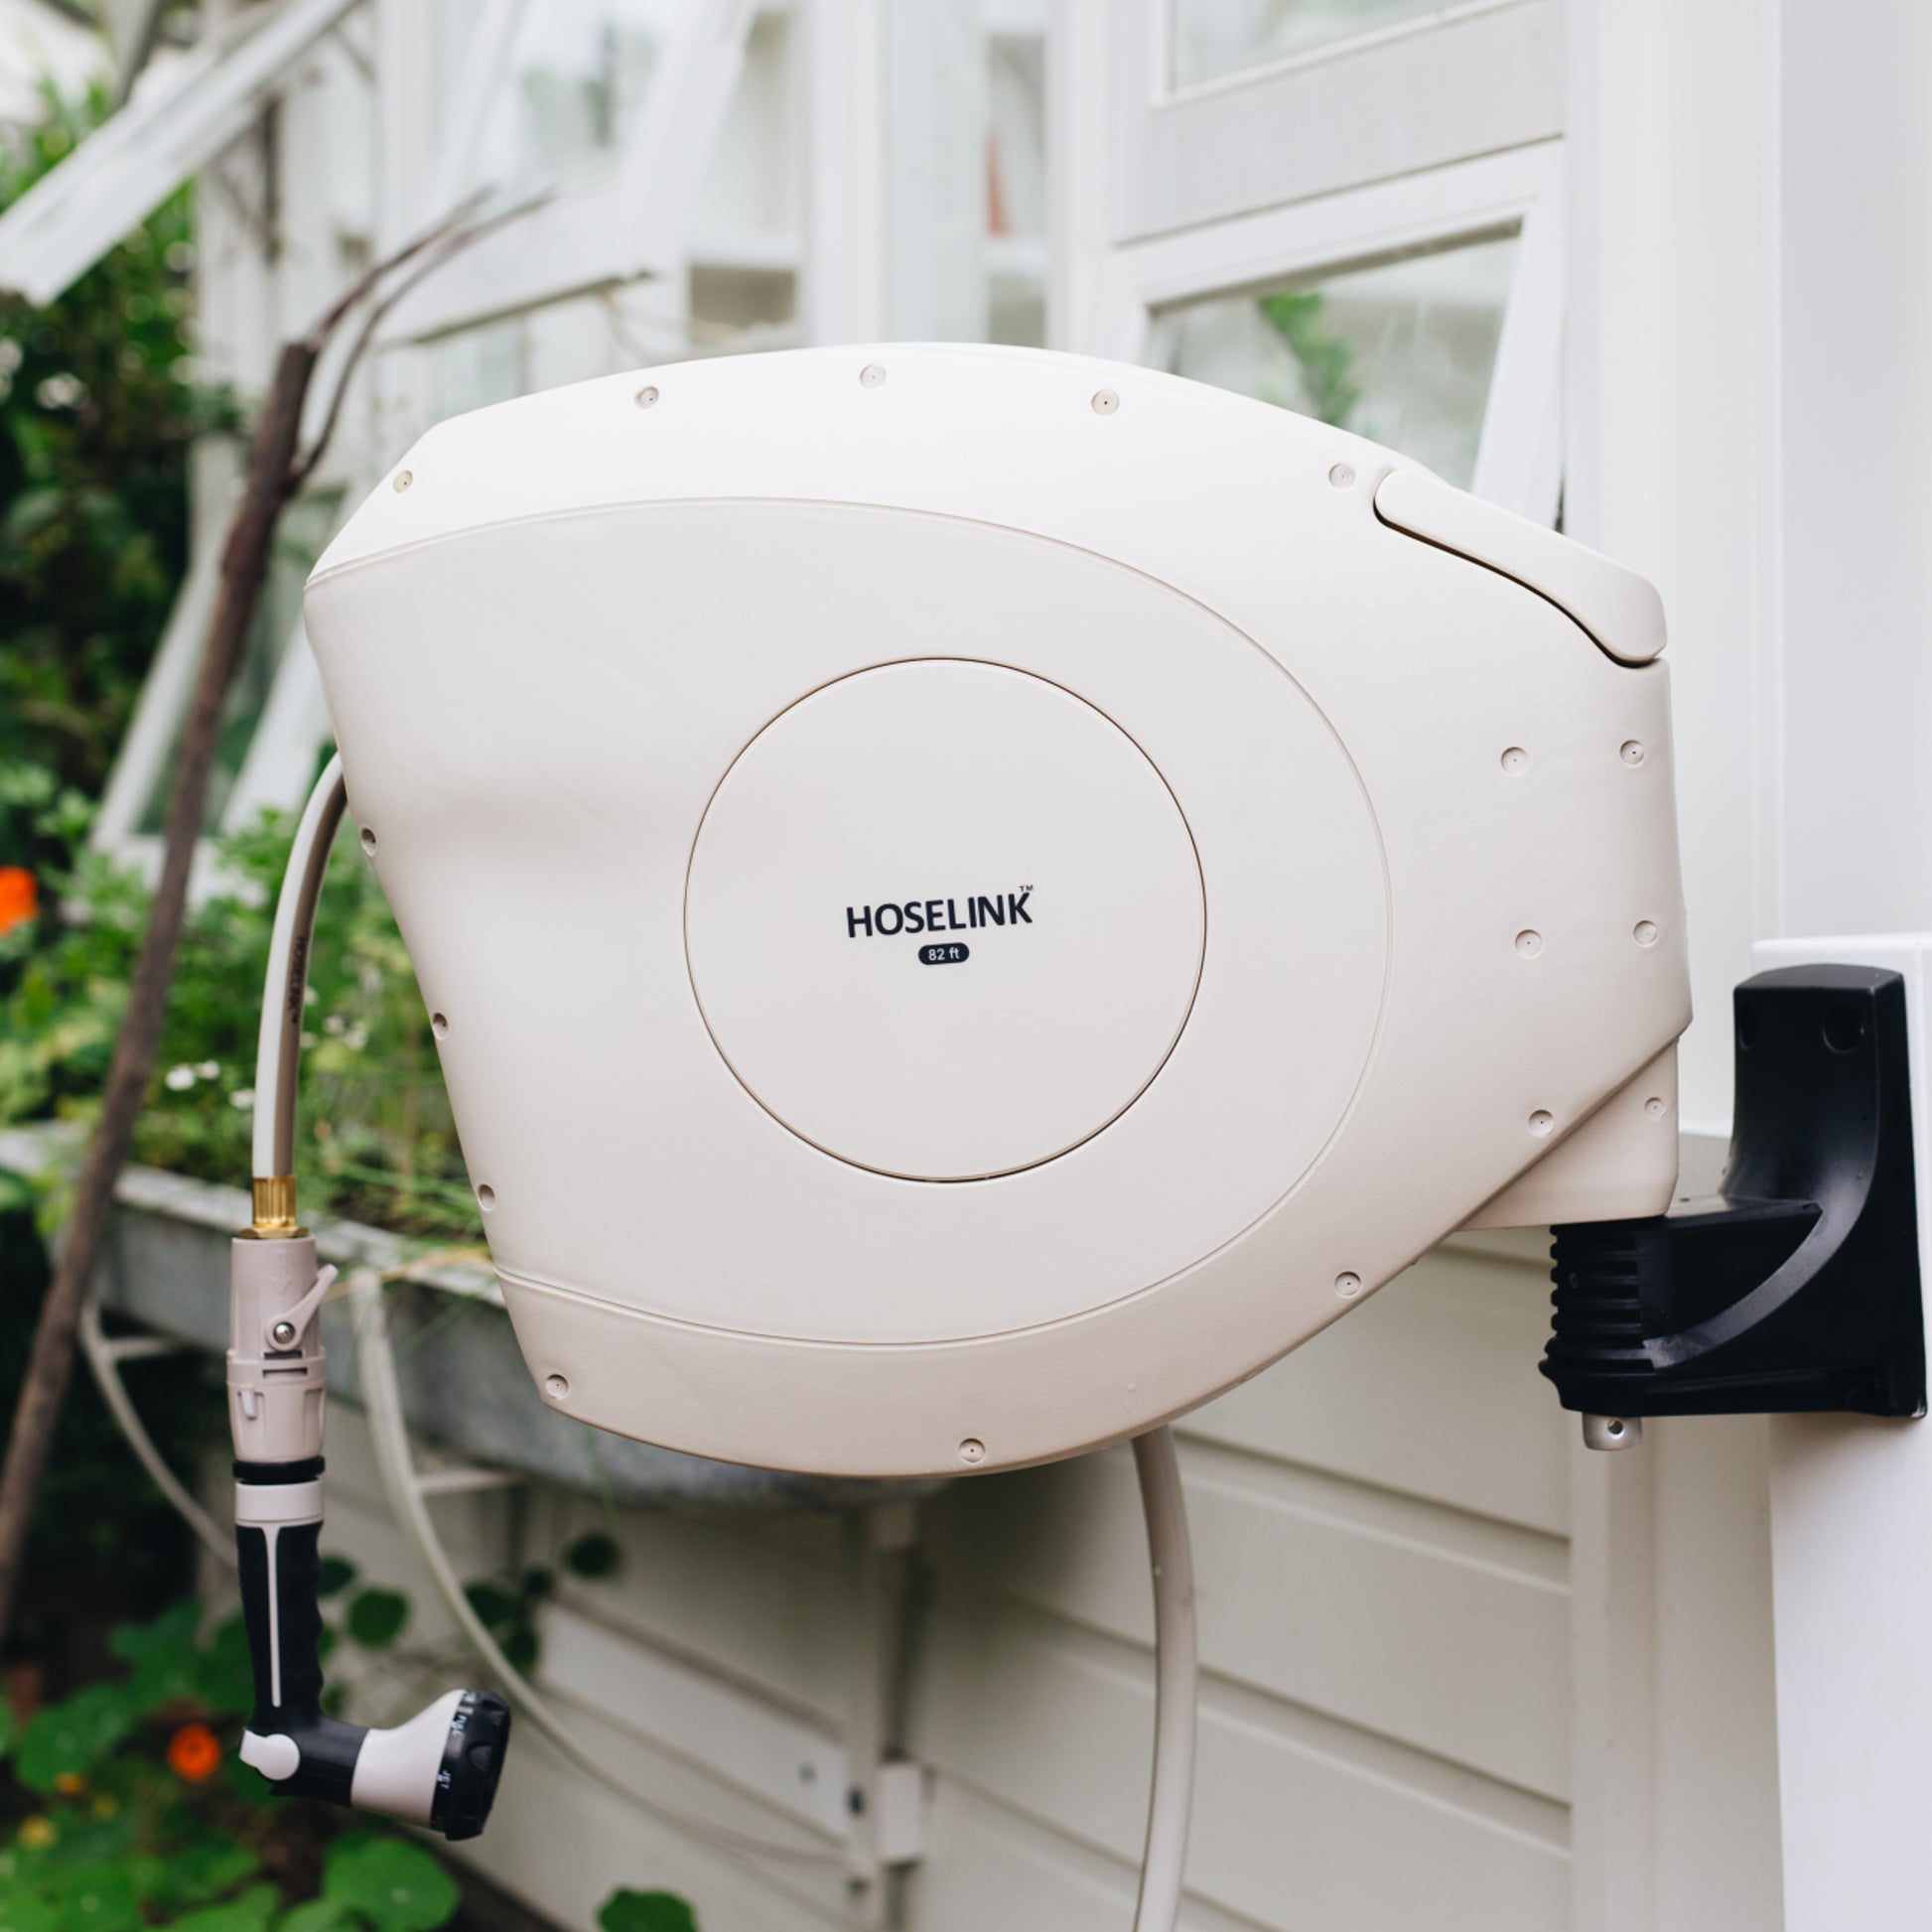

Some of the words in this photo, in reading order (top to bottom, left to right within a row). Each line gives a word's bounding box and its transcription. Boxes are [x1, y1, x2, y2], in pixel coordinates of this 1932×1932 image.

[847, 893, 1033, 937] HOSELINK
[928, 948, 945, 961] 82
[949, 946, 960, 960] ft
